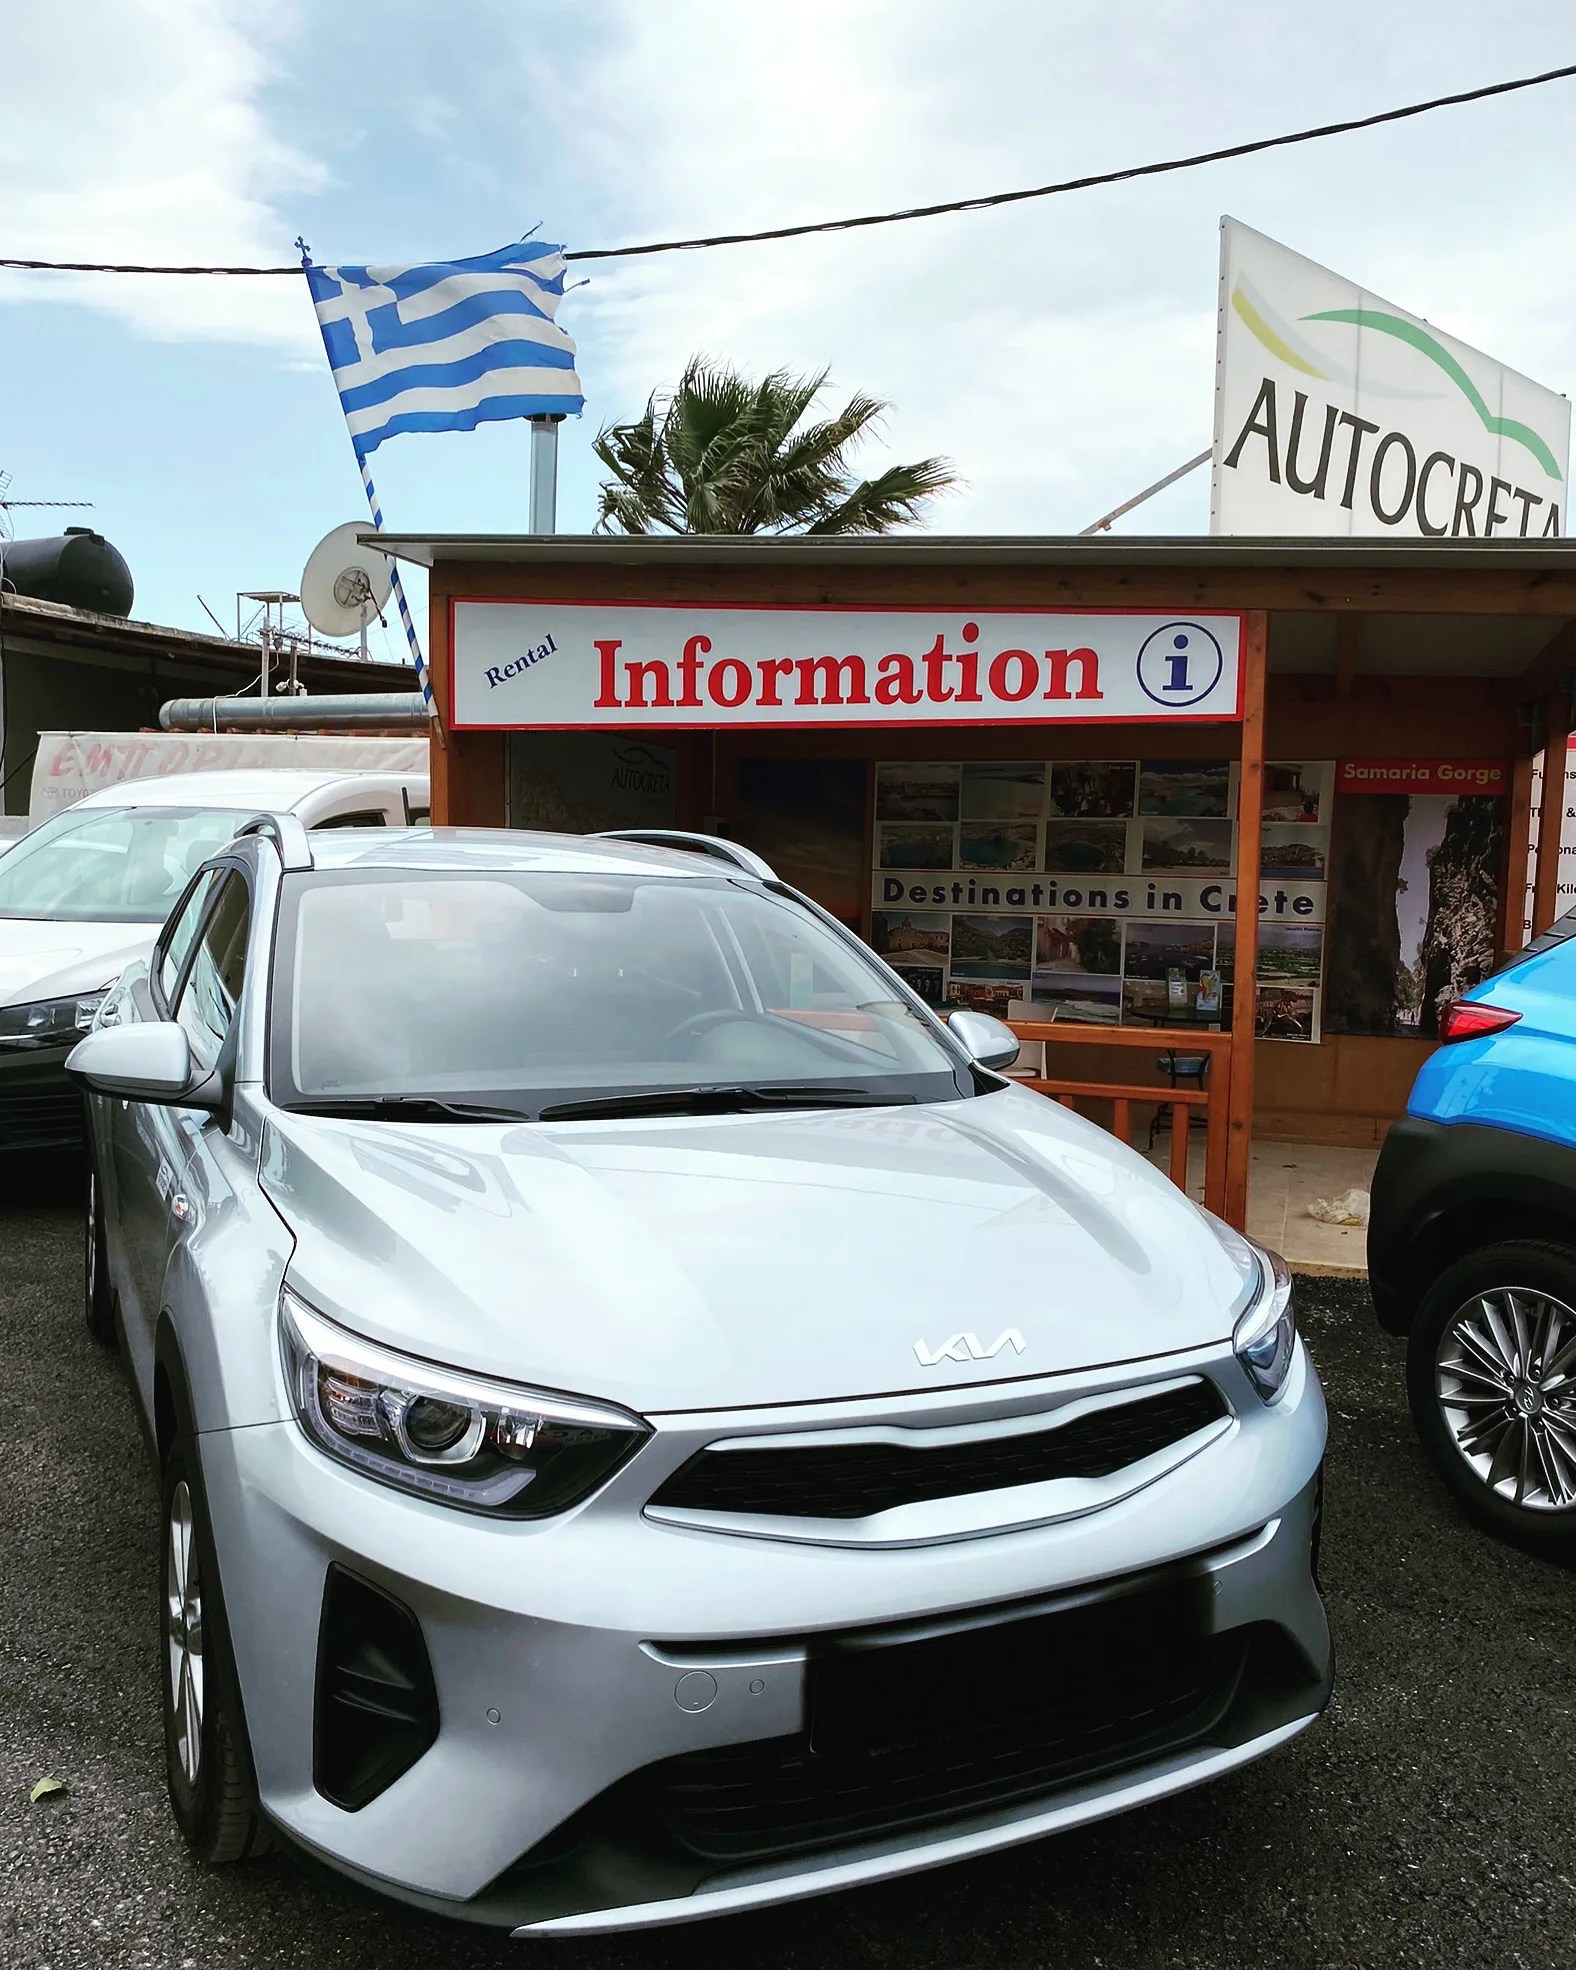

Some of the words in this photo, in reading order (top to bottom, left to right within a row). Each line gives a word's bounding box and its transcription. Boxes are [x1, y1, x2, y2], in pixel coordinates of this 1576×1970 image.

[484, 633, 559, 689] Rental
[593, 623, 1105, 709] Information
[611, 767, 670, 794] AUTOCRETA
[1343, 764, 1430, 780] Samaria
[1437, 764, 1502, 785] Gorge
[883, 878, 1130, 909] Destinations
[1147, 883, 1182, 910] in
[912, 1327, 1027, 1367] KIA
